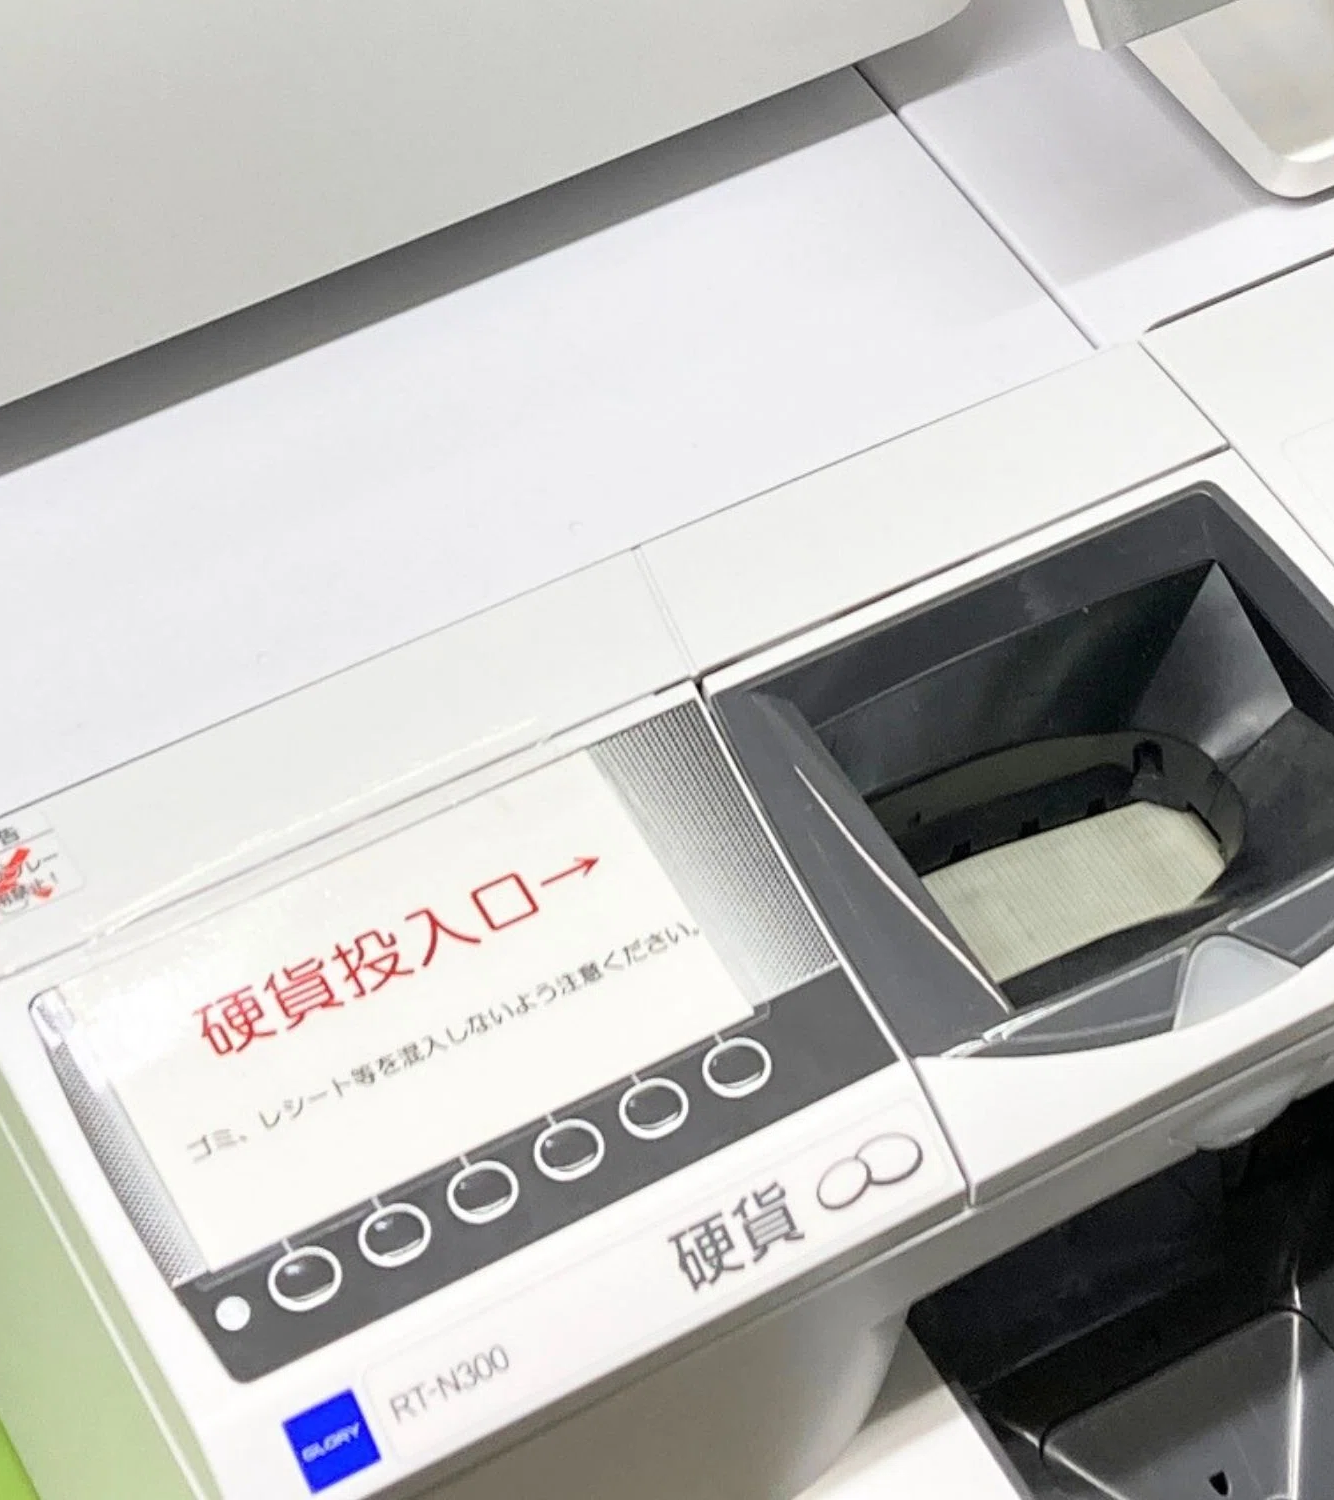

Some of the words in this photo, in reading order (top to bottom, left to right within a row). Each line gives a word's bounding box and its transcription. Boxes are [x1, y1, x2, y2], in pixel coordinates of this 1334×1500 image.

[191, 871, 540, 1058] 硬貨投入口
[186, 922, 703, 1164] ゴミ、レシート等を混入しないよう注意ください。
[667, 1179, 805, 1292] 硬貨
[388, 1343, 510, 1424] RT-N300
[300, 1421, 361, 1464] GLORY
